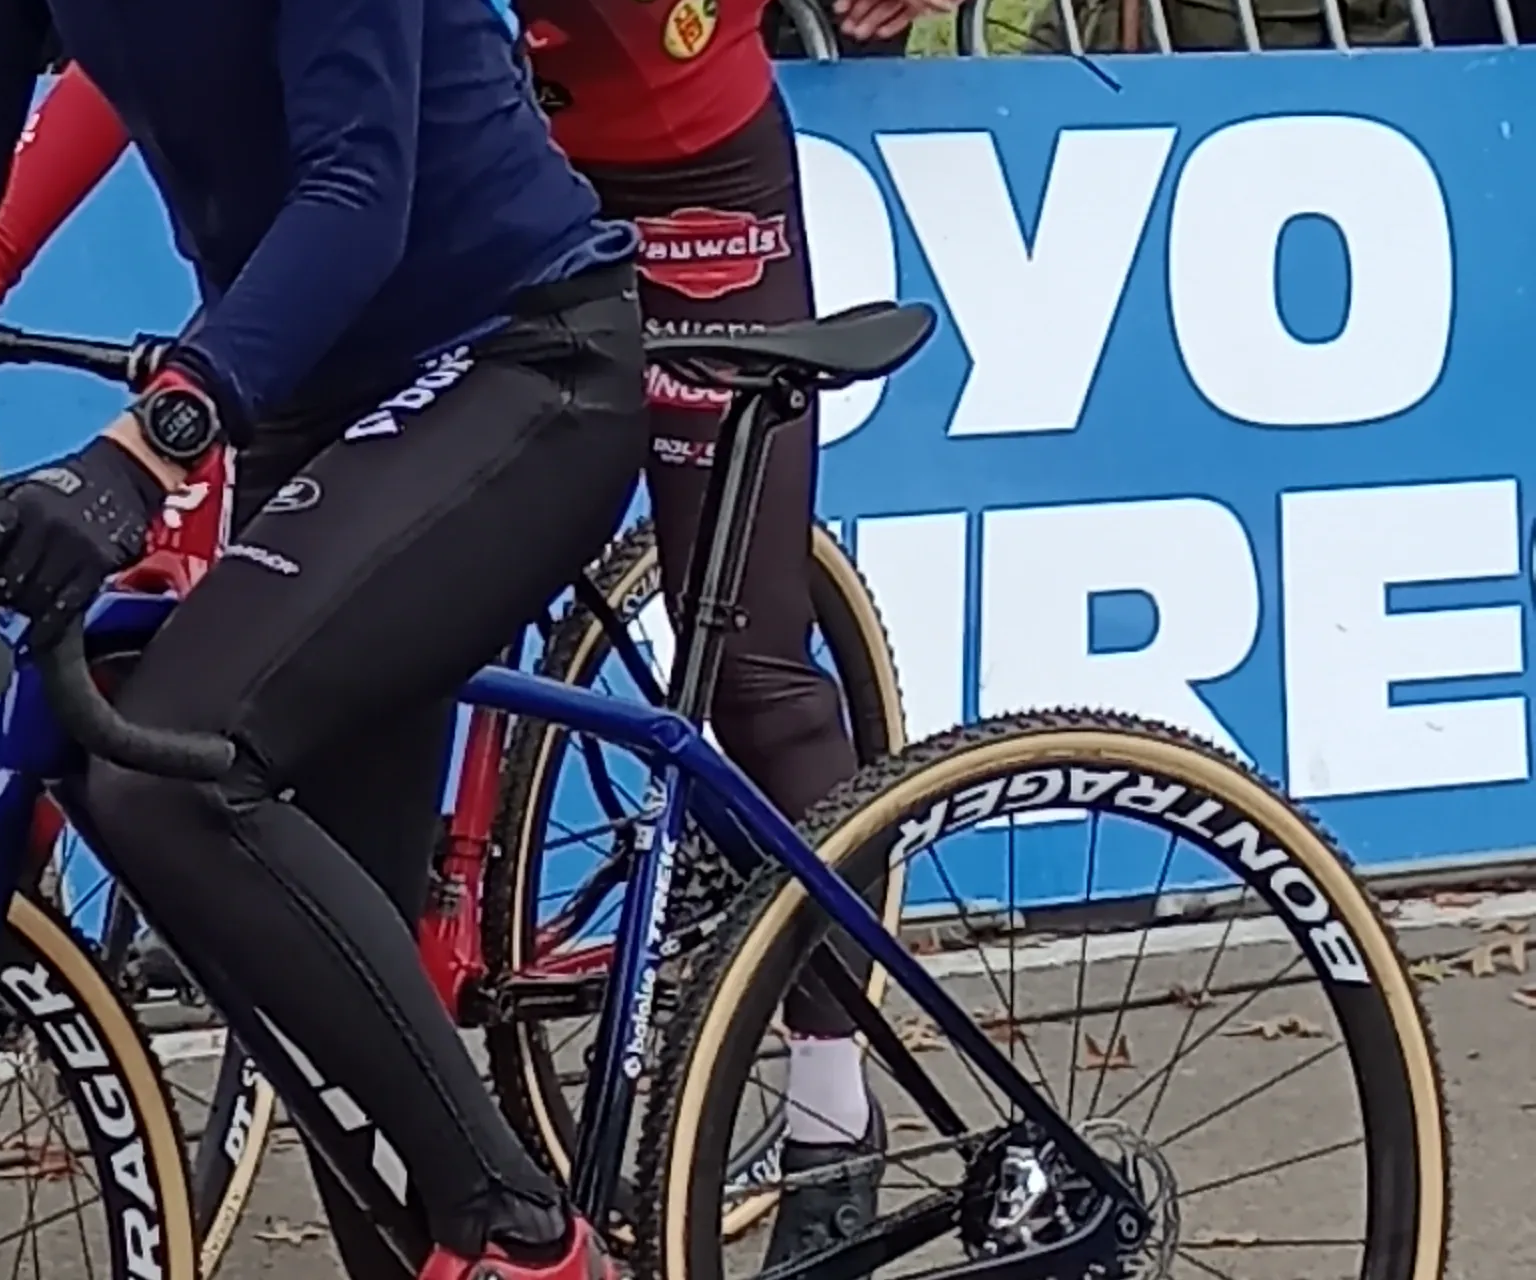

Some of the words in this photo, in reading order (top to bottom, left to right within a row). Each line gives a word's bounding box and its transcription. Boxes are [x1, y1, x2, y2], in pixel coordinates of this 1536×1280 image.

[638, 226, 776, 260] auwels
[890, 766, 1372, 985] BONTRAGER
[0, 961, 163, 1280] RAGER
